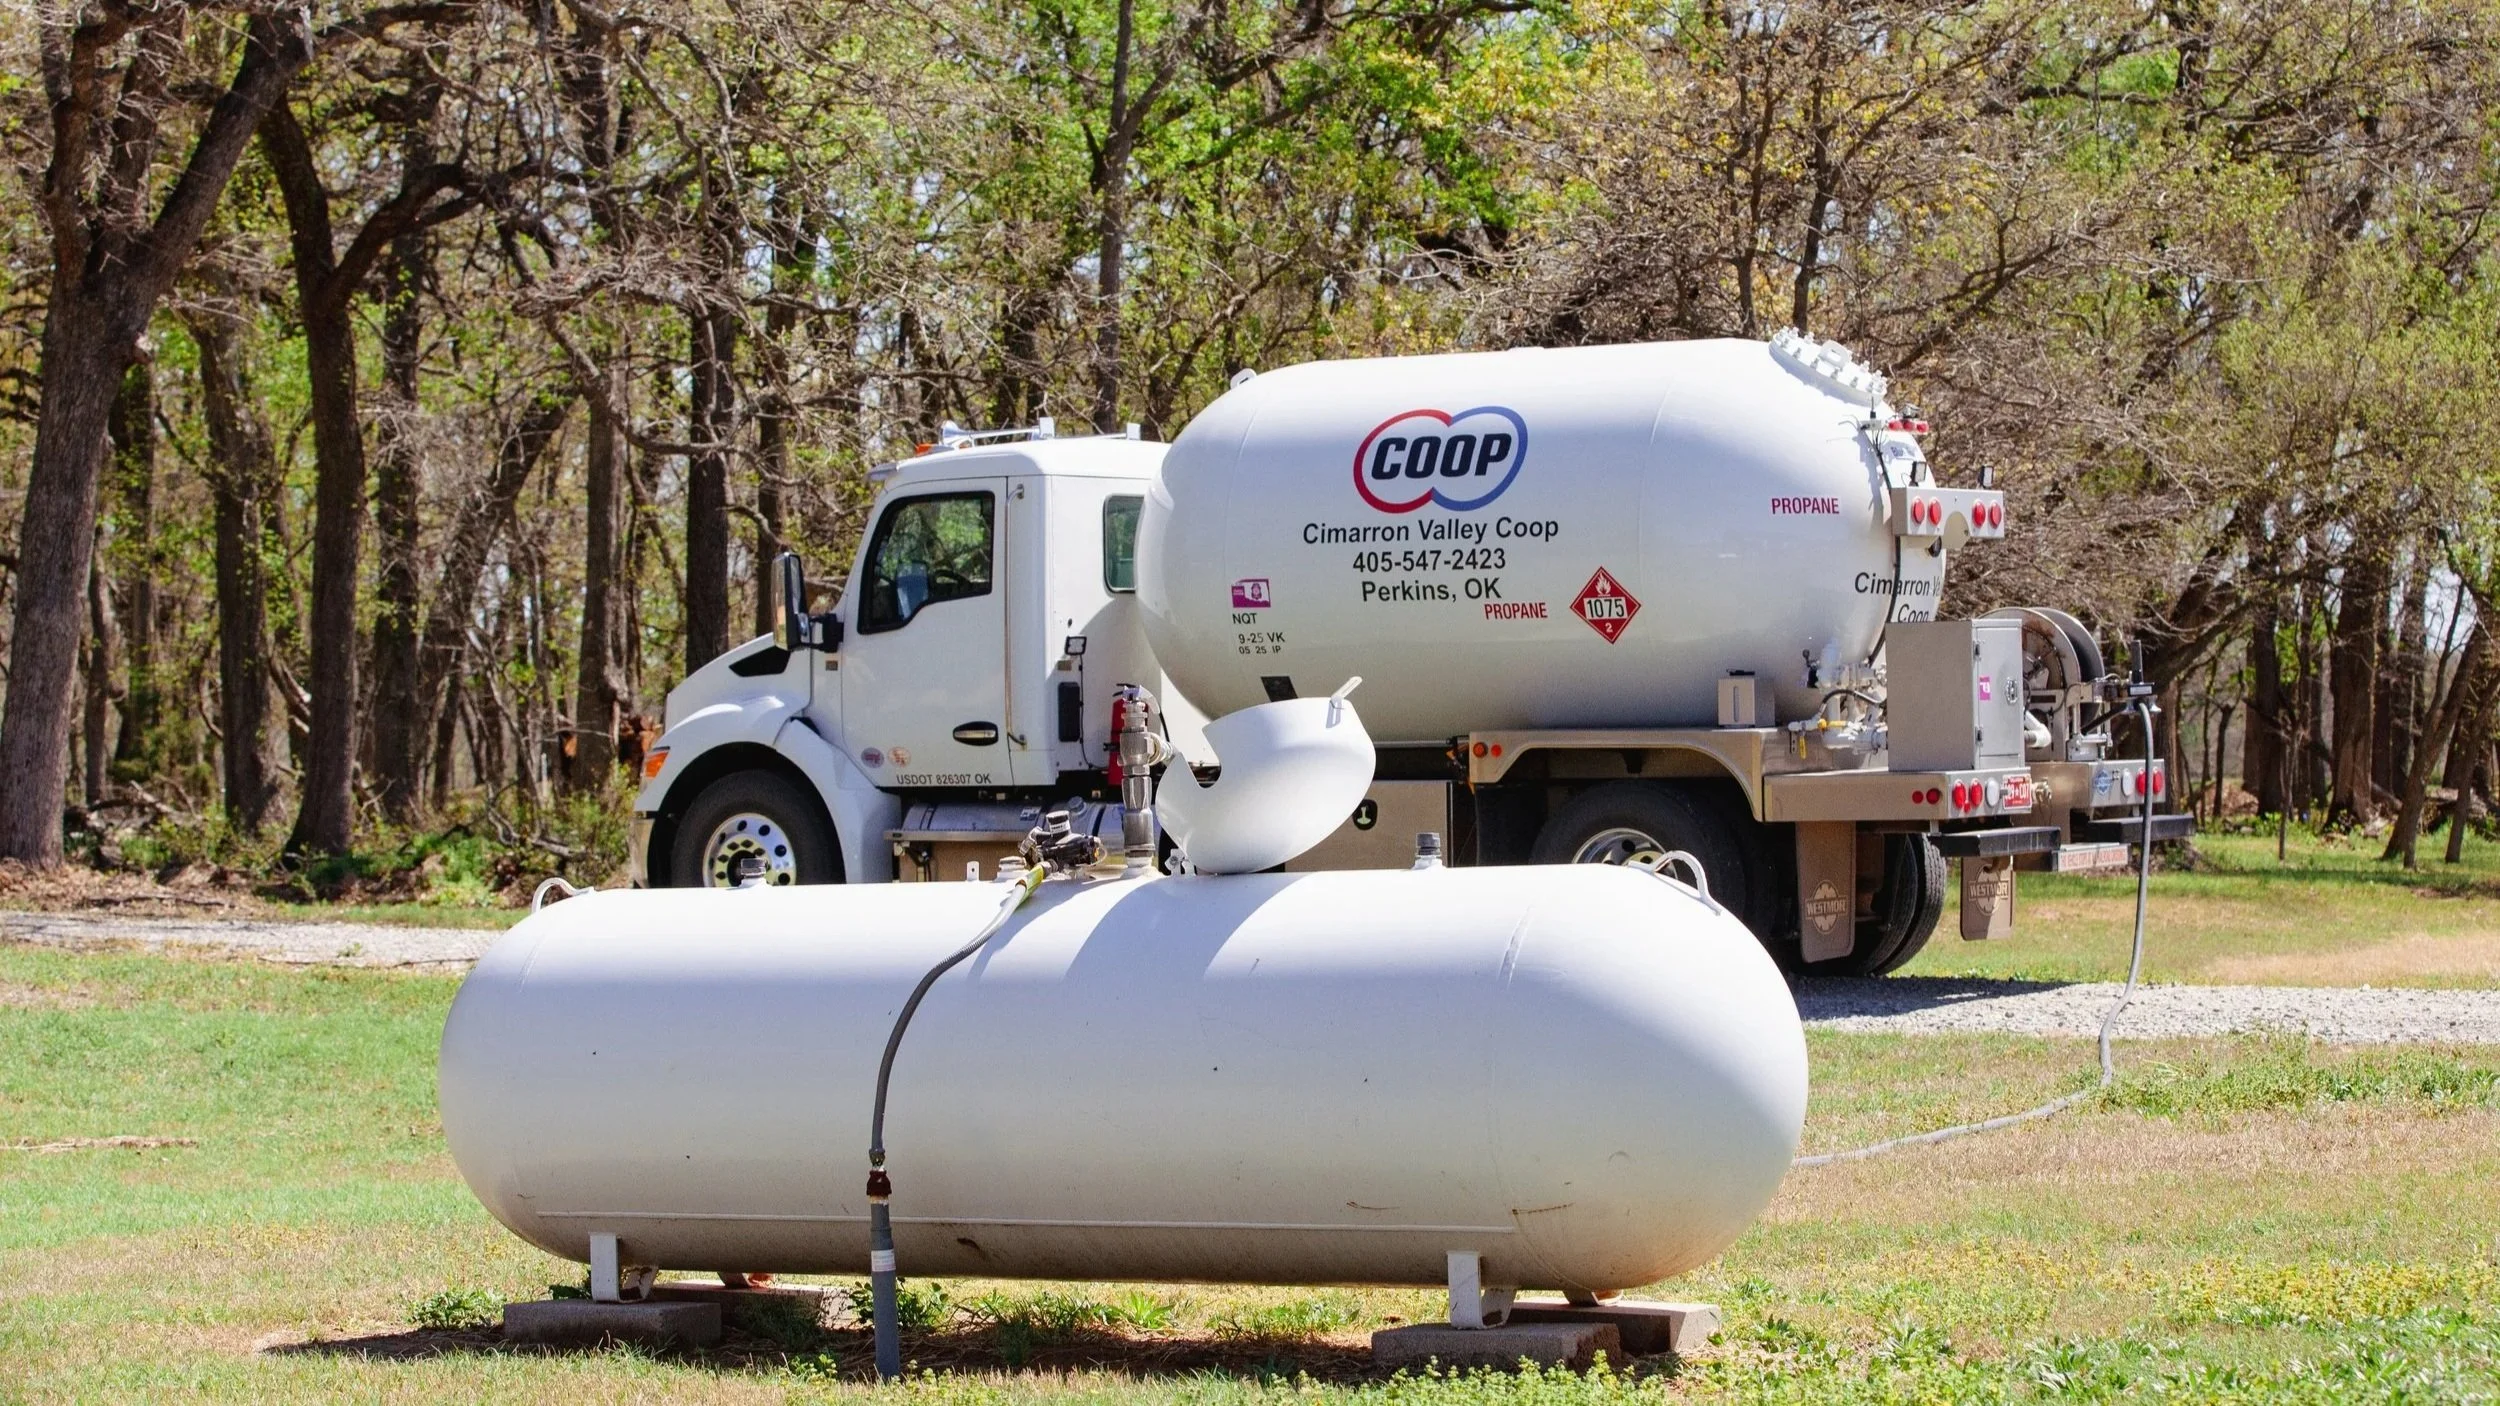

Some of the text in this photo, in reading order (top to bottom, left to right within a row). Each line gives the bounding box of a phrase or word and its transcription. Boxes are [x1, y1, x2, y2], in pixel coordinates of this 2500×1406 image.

[1371, 433, 1512, 480] COOP
[1771, 497, 1840, 515] PROPANE
[1303, 516, 1559, 545] Cimarron Valley Coop
[1352, 547, 1506, 573] 405-547-2423
[1361, 577, 1502, 603] Perkins, OK
[1484, 602, 1548, 620] PROPANE
[1587, 598, 1625, 618] 1075
[1232, 612, 1257, 624] NQT
[1605, 622, 1613, 633] 2
[1238, 631, 1286, 644] 9-25 VK
[1238, 645, 1251, 655] 05
[1255, 645, 1267, 655] 25
[896, 773, 992, 785] USDOT 826307 OK
[1969, 881, 2008, 898] WESTMOR
[1806, 899, 1847, 916] WESTMOR
